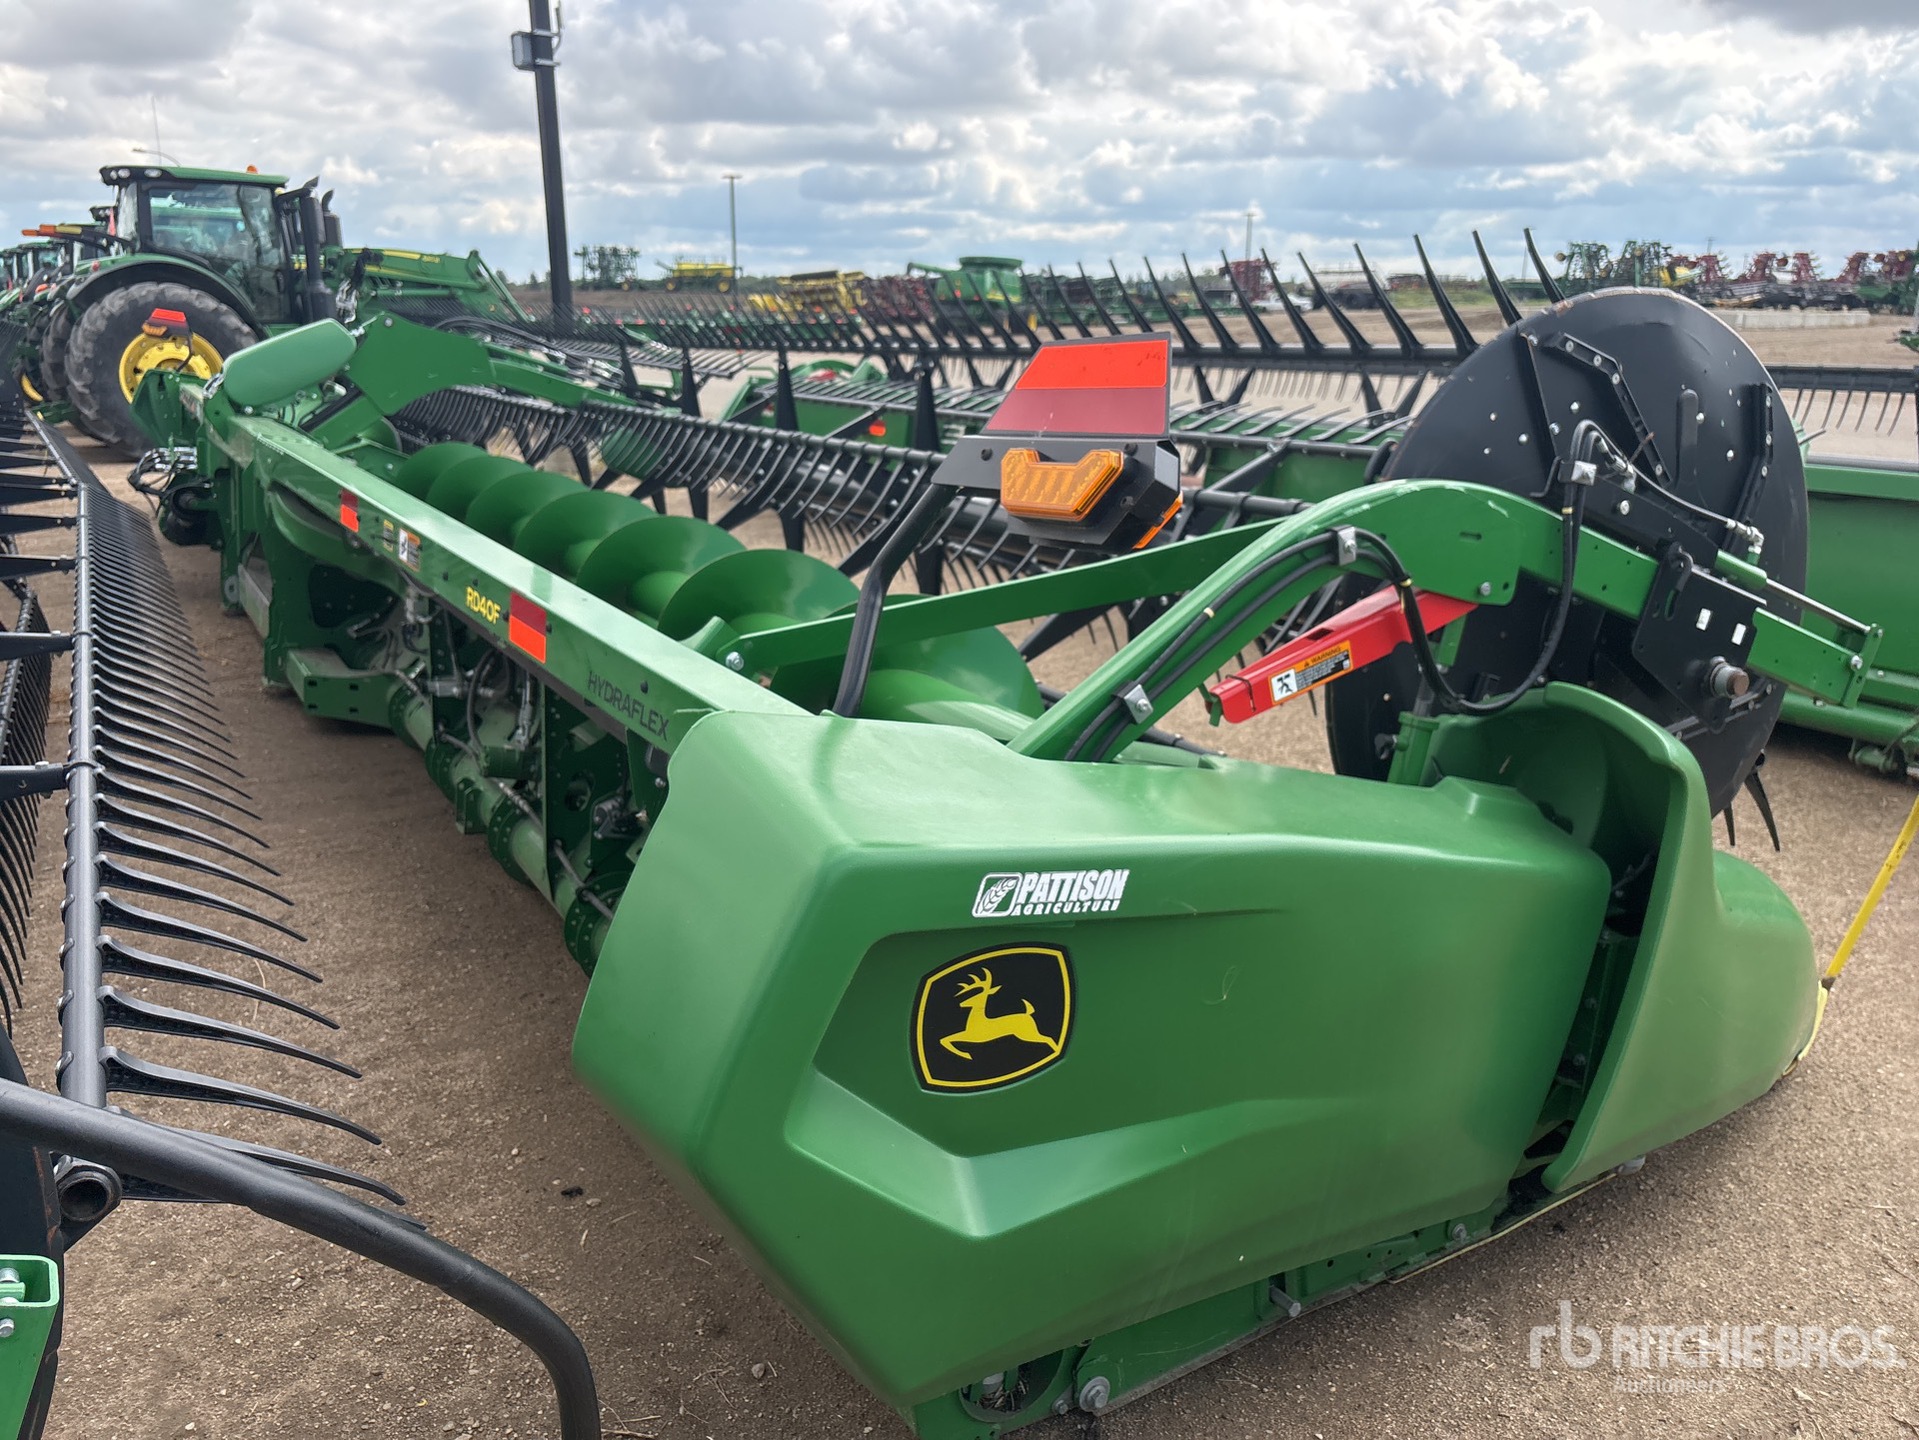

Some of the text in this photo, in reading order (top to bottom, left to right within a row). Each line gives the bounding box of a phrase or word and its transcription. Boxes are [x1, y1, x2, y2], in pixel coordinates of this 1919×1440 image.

[466, 586, 501, 625] RD40F
[1310, 646, 1341, 662] WARNING
[587, 670, 670, 741] HYDRAFLEX
[1016, 869, 1130, 904] PATTISON
[1010, 899, 1120, 916] AGRICULTURE
